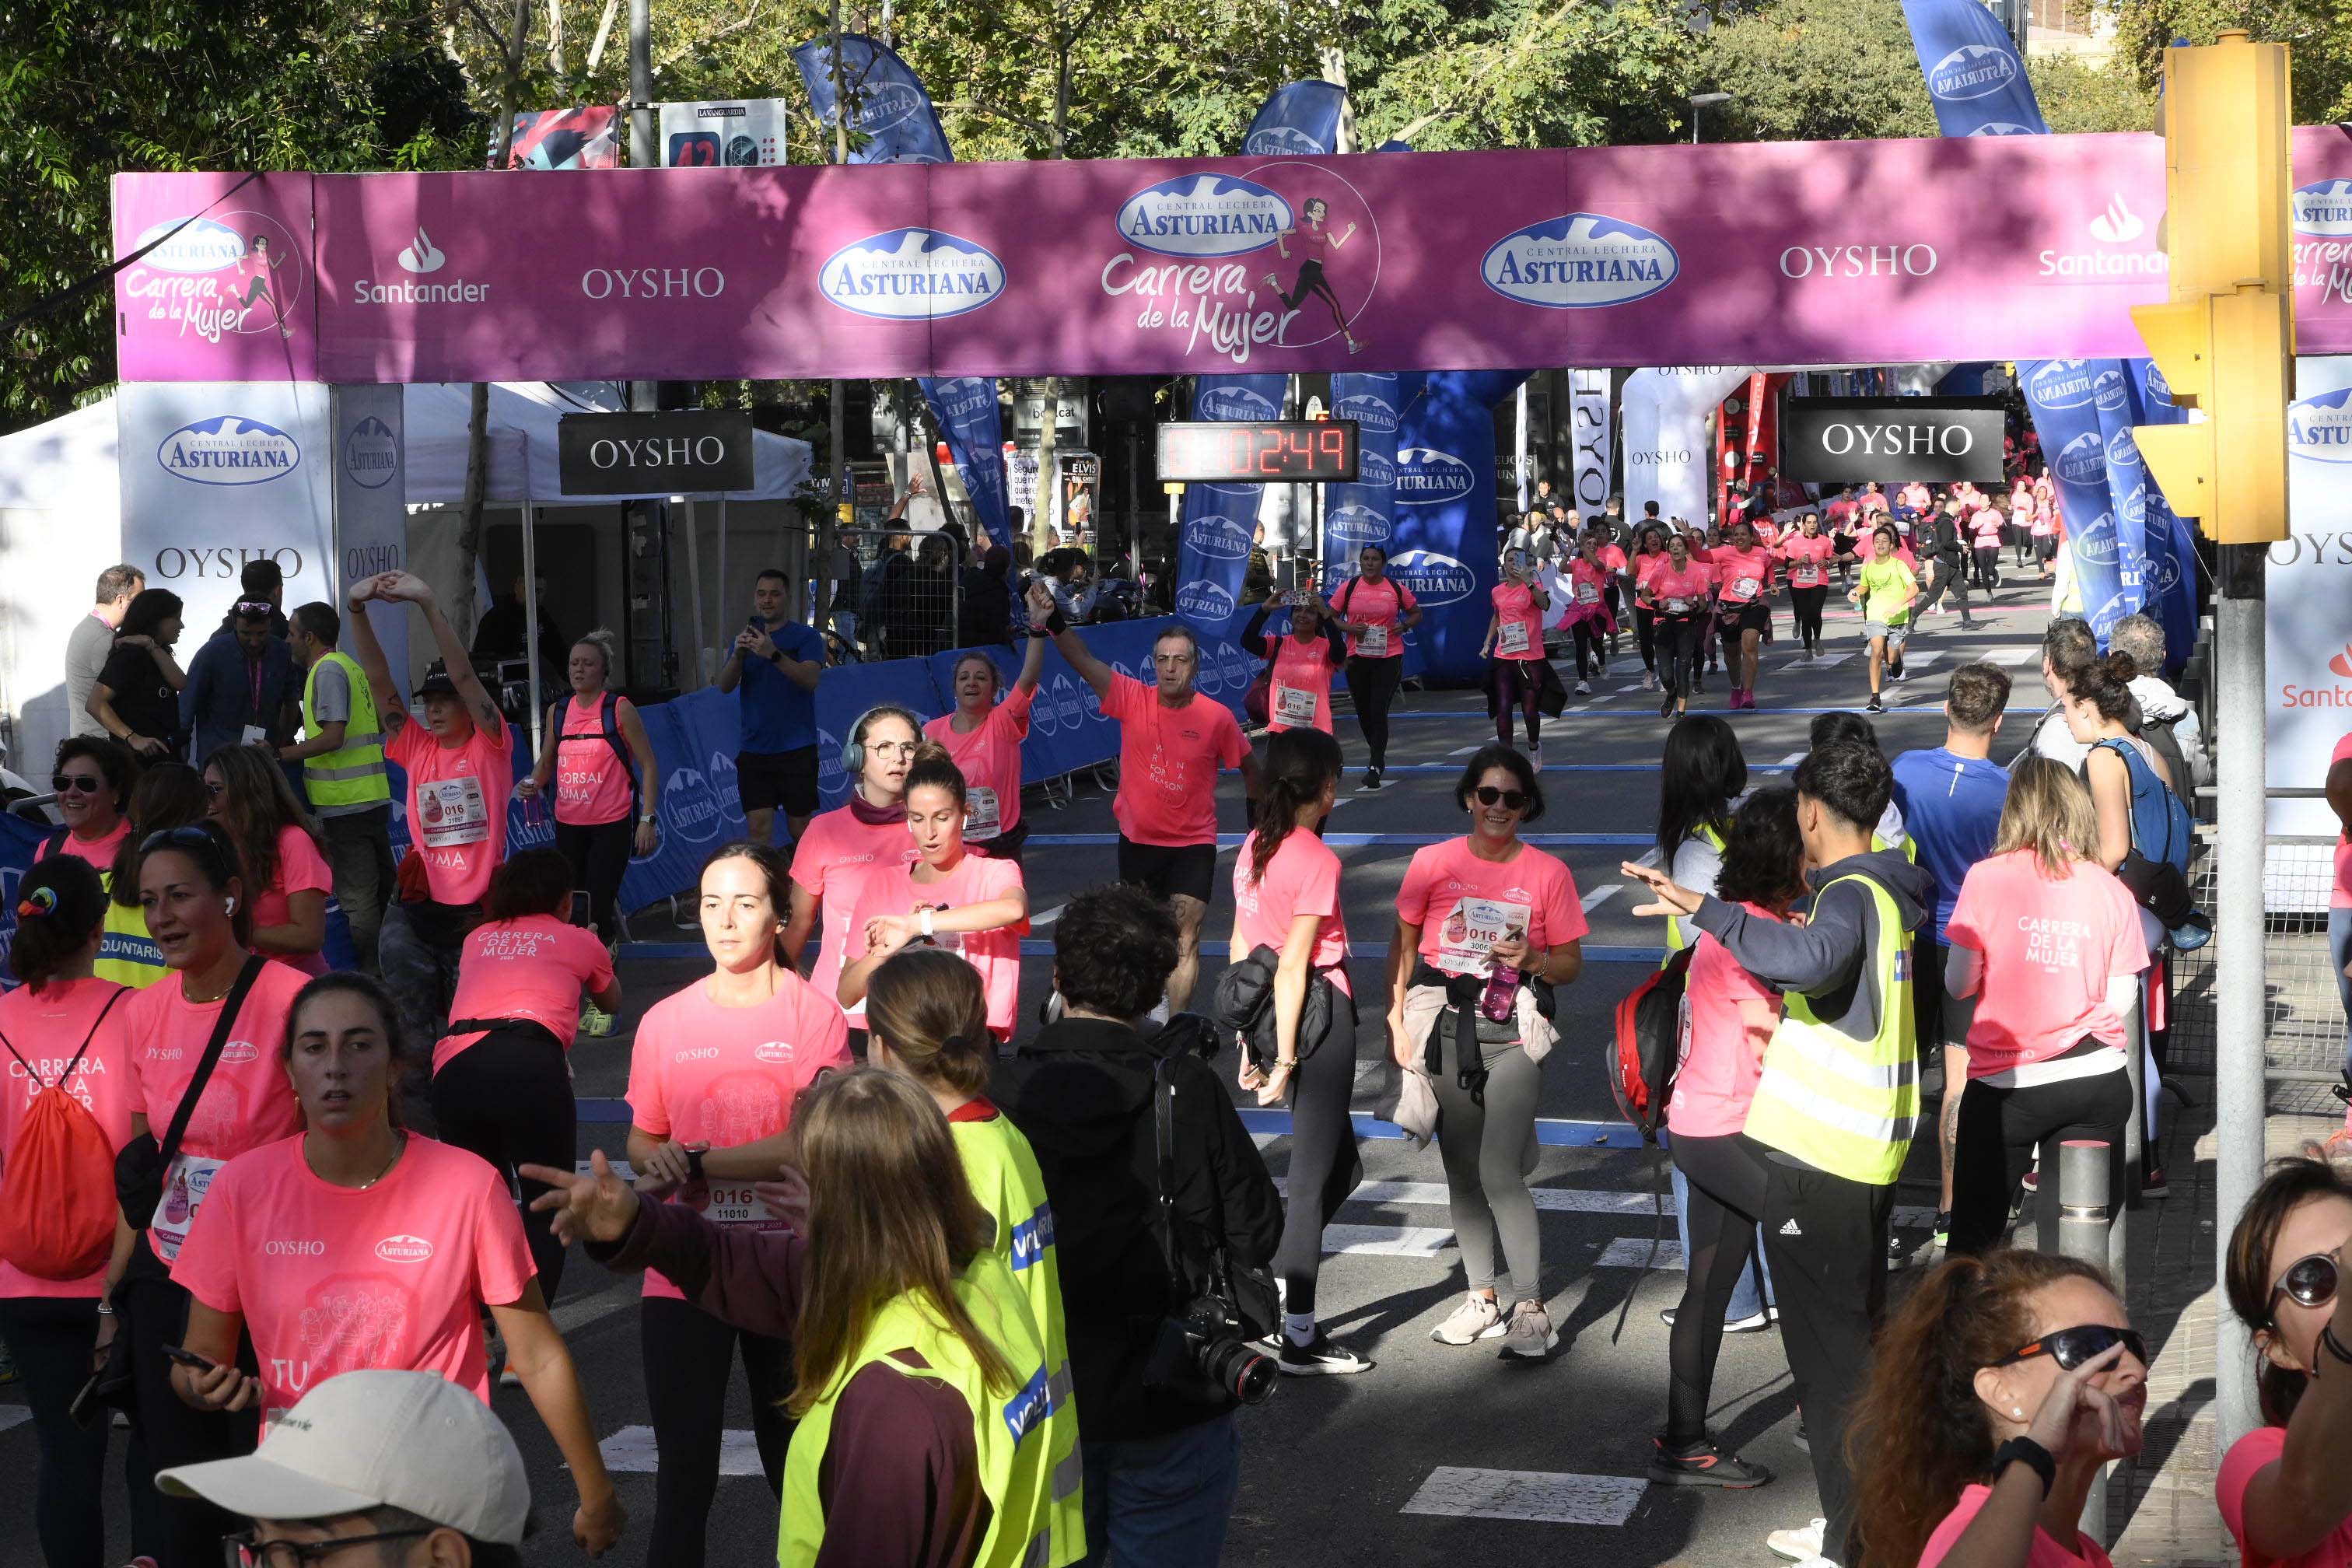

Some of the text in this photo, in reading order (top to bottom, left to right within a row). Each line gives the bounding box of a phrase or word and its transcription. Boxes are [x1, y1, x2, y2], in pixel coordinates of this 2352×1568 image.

[1157, 201, 1275, 210] CENTRAL LECHERA
[1130, 205, 1279, 236] ASTURIANA
[1527, 245, 1657, 257] CENTRAL LECHERA
[1780, 243, 1937, 278] OYSHO
[862, 258, 985, 268] CENTRAL LECHERA
[1496, 252, 1663, 285] ASTURIANA
[125, 268, 218, 298] Carrera
[582, 267, 726, 299] OYSHO
[833, 262, 992, 296] ASTURIANA
[1101, 253, 1248, 296] Carrera
[2311, 265, 2325, 286] la
[355, 279, 490, 304] Santander
[149, 296, 182, 320] de la
[1137, 296, 1189, 328] de la
[179, 296, 253, 344] Mujer
[1185, 291, 1301, 364] Mujer
[1204, 396, 1272, 421] ASTURIANA
[1339, 403, 1395, 429] ASTURIANA
[240, 439, 285, 447] LECHERA
[1575, 369, 1605, 507] OYSH
[1822, 423, 1973, 457] OYSHO
[170, 441, 290, 468] ASTURIANA
[349, 450, 395, 471] ASTURIANA
[590, 436, 725, 469] OYSHO
[1633, 449, 1692, 465] OYSHO
[1072, 463, 1096, 473] ELVIS
[1360, 467, 1392, 482] RIANA
[1331, 521, 1387, 537] ASTURIANA
[1187, 527, 1246, 554] ASTURIANA
[2266, 532, 2352, 567] OYS
[347, 544, 399, 579] OYSHO
[1150, 764, 1166, 776] FOR
[1150, 772, 1183, 792] REASON
[559, 786, 590, 800] SUMA
[444, 804, 464, 815] 016
[840, 853, 873, 863] OYSHO
[1470, 910, 1502, 922] ASTURIANA
[1469, 928, 1497, 942] 016
[2018, 915, 2091, 939] CARRERA
[478, 931, 556, 944] CARRERA
[487, 938, 510, 947] DE
[2030, 933, 2077, 953] DE LA
[481, 946, 537, 957] MUJER
[2025, 947, 2079, 968] MUJER
[1444, 958, 1469, 967] OYSHO
[675, 1047, 719, 1064] OYSHO
[9, 1056, 106, 1079] CARRERA
[190, 1176, 210, 1188] AST
[713, 1189, 753, 1204] 016
[717, 1209, 749, 1219] 11010
[162, 1233, 184, 1243] CARRE
[265, 1241, 325, 1255] OYSHO
[379, 1244, 429, 1256] ASTURIANA
[271, 1359, 308, 1391] TU
